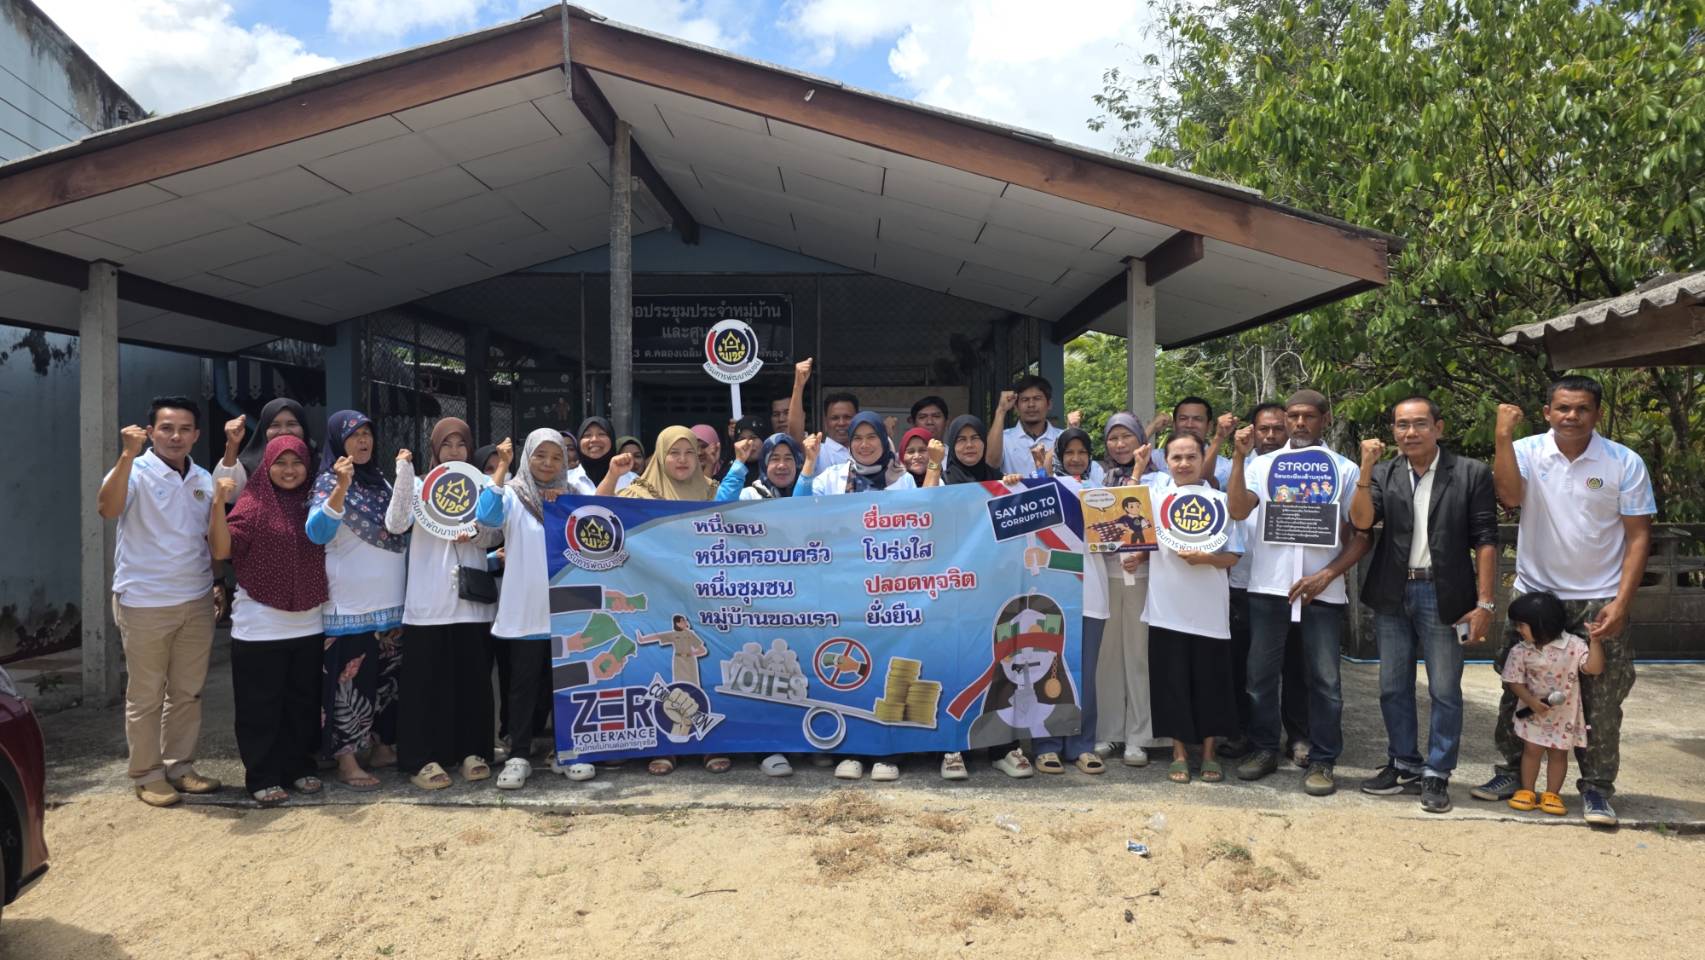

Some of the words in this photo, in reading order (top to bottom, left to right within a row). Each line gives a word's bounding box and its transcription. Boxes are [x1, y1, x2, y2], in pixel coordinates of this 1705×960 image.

[633, 300, 781, 324] อประชุมประจำหมู่บ้าน
[1277, 461, 1329, 472] STRONG
[863, 504, 932, 530] ซื่อตรง
[995, 505, 1017, 520] SAY
[1020, 500, 1038, 514] NO
[1039, 496, 1056, 508] TO
[1000, 508, 1056, 529] CORRUPTION
[694, 513, 764, 536] หนึ่งคน
[695, 539, 831, 565] หนึ่งครอบครัว
[862, 536, 932, 562] โปร่งใส
[695, 571, 794, 604] หนึ่งชุมชน
[865, 567, 977, 598] ปลอดทุจริต
[699, 606, 839, 631] หมู่บ้านของเรา
[867, 600, 922, 626] ยั่งยืน
[722, 660, 808, 701] VOTES
[573, 728, 656, 745] TOLERANCE
